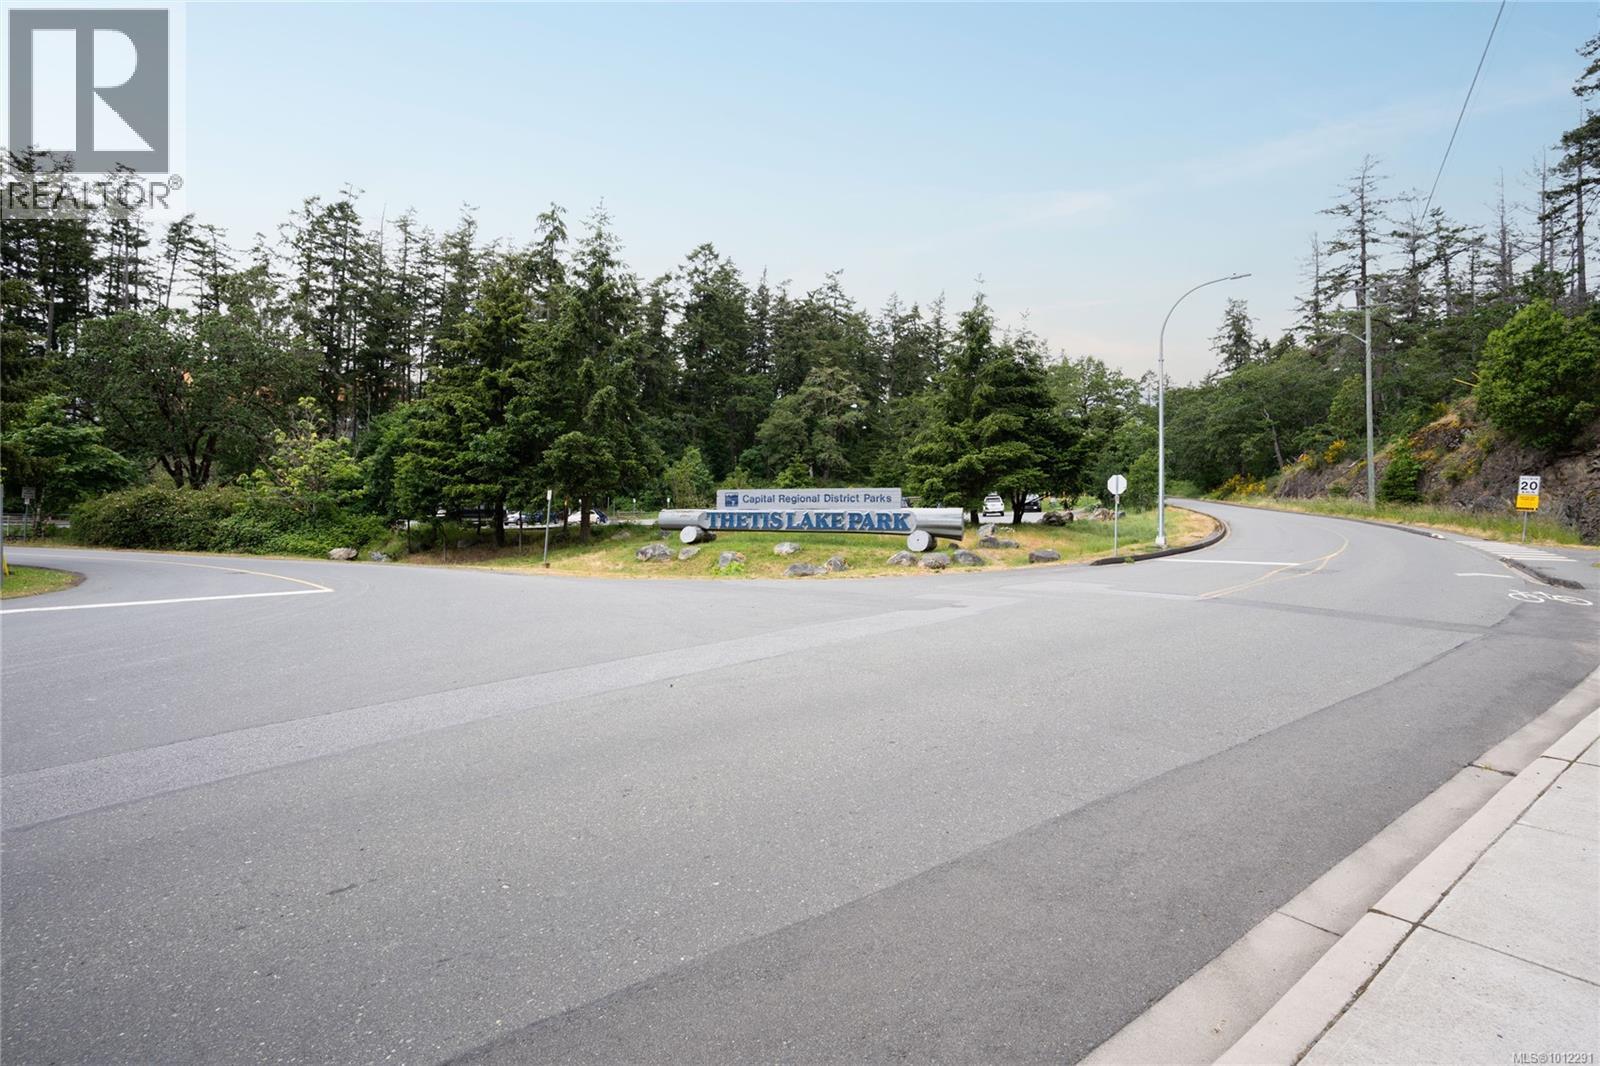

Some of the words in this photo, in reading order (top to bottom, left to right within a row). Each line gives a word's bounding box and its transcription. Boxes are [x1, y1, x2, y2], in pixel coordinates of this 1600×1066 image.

[1521, 481, 1538, 490] 20
[742, 494, 775, 504] Capital
[778, 494, 820, 505] Regional
[823, 493, 860, 503] District
[863, 493, 892, 503] Parks
[706, 511, 784, 529] THETIS
[785, 511, 845, 530] LAKE
[847, 512, 911, 531] PARK
